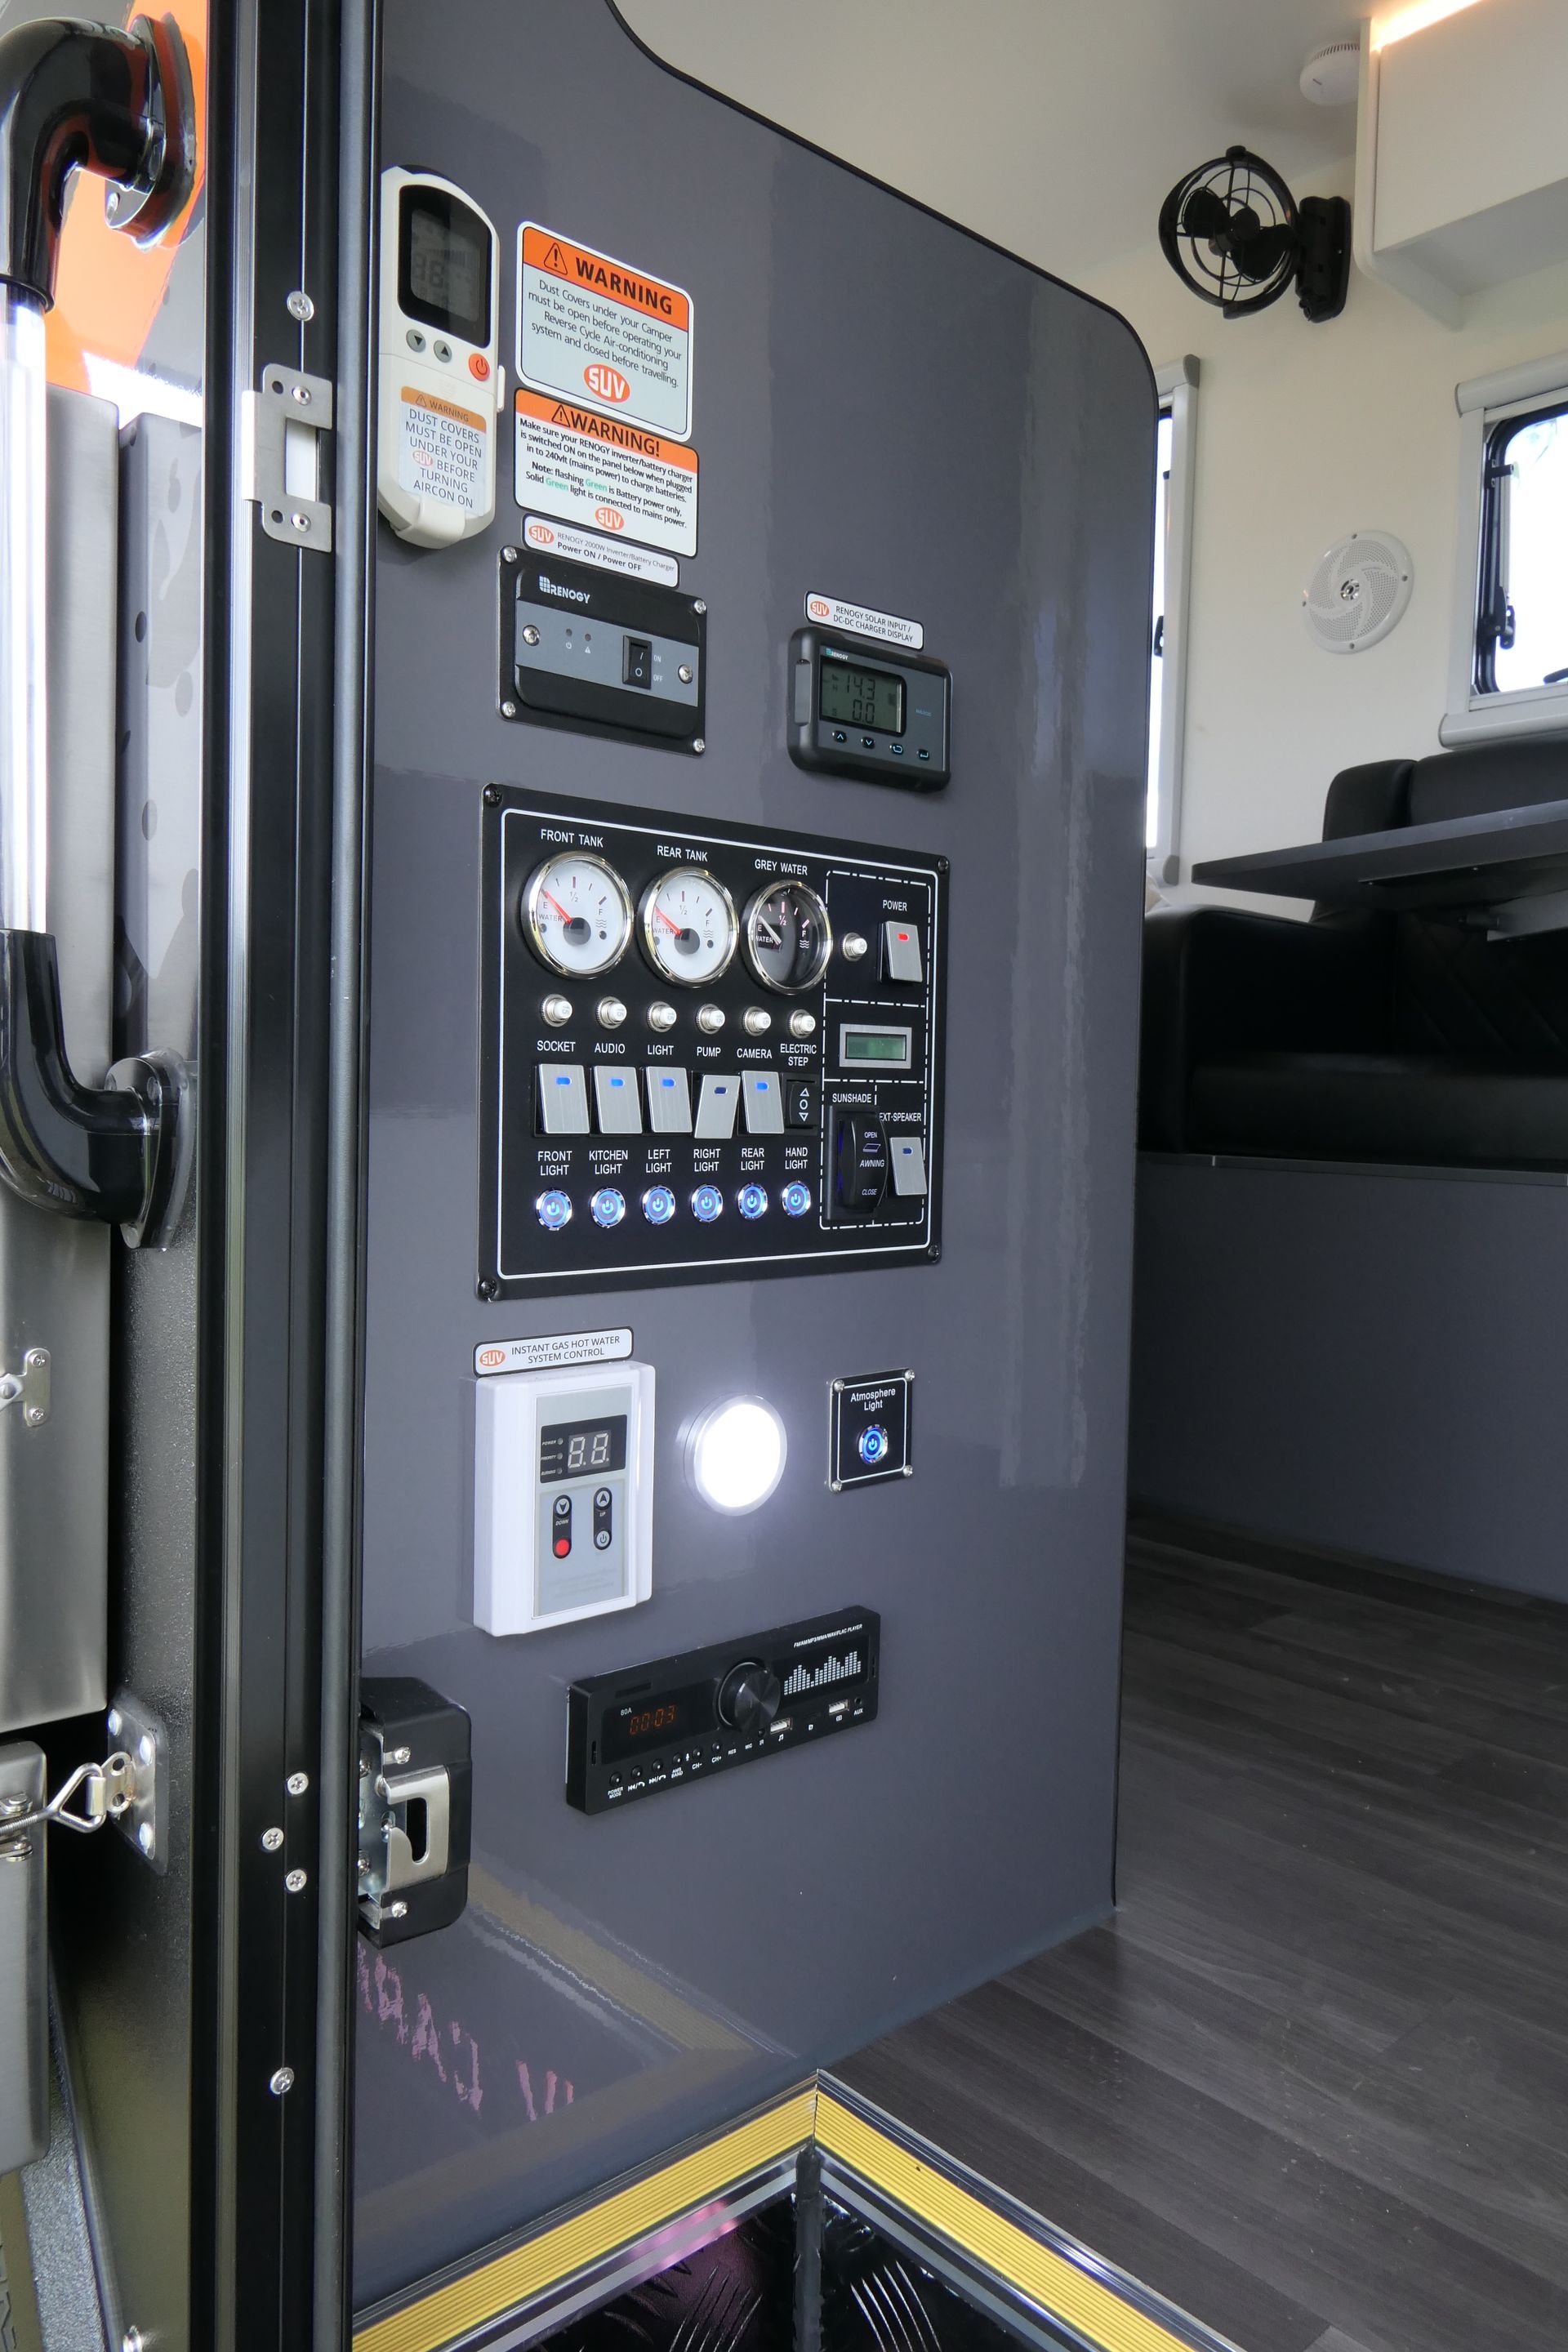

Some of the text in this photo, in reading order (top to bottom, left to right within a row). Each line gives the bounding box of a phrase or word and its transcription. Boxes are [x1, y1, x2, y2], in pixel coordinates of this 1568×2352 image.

[576, 257, 672, 314] WARNING
[539, 279, 673, 343] Dust Covers under your Camper
[528, 292, 681, 360] must be open before operating your
[544, 311, 668, 371] Reverse Cycle Air-conditioning
[532, 323, 679, 388] system and closed before travelling.
[589, 368, 626, 399] SUV
[430, 400, 469, 422] WARNING
[410, 409, 479, 443] DUST COVERS
[571, 411, 660, 457] WARNING!
[406, 421, 482, 458] MUST BE OPEN
[410, 437, 478, 470] UNDER YOUR
[520, 418, 693, 483] Make sure your RENOGY inverter/battery charger
[414, 452, 474, 482] SUV BEFORE
[520, 430, 527, 439] is
[528, 434, 562, 450] switched
[564, 444, 575, 455] ON
[588, 453, 600, 463] the
[603, 458, 621, 470] panel
[624, 465, 644, 477] below
[646, 473, 665, 483] when
[666, 479, 692, 493] plugged
[421, 468, 467, 492] TURNING
[527, 443, 533, 452] in
[536, 448, 543, 456] to
[546, 450, 568, 464] 240vlt
[569, 458, 594, 473] (mains
[595, 468, 621, 483] power)
[630, 478, 653, 492] charge
[655, 485, 687, 503] batteries.
[414, 480, 473, 508] AIRCON ON
[532, 461, 682, 516] Note: flashing Green is Battery power only,
[526, 471, 544, 483] Solid
[546, 478, 568, 491] Green
[570, 485, 586, 497] light
[588, 491, 594, 499] is
[595, 494, 632, 511] connected
[642, 509, 662, 521] mains
[665, 515, 687, 528] power.
[599, 510, 621, 528] SUV
[532, 527, 674, 571] SUV RENOGY 2000W Inverter/Battery Charger
[558, 542, 581, 554] Power
[584, 550, 595, 559] ON
[603, 555, 626, 567] Power
[628, 562, 642, 571] OFF
[550, 584, 590, 604] RENOGY
[812, 603, 827, 615] SUV
[836, 605, 863, 619] RENOGY
[865, 614, 885, 626] SOLAR
[888, 621, 906, 631] INPUT
[834, 615, 912, 642] DC-DC CHARGER DISPLAY
[541, 829, 604, 848] FRONT TANK
[657, 845, 707, 862] REAR TANK
[755, 859, 808, 875] GREY WATER
[883, 900, 907, 911] POWER
[539, 914, 563, 922] WATER
[537, 1040, 576, 1052] SOCKET
[595, 1043, 626, 1054] AUDIO
[648, 1045, 674, 1055] LIGHT
[697, 1047, 721, 1057] PUMP
[737, 1049, 772, 1058] CAMERA
[780, 1044, 817, 1054] ELECTRIC
[788, 1057, 808, 1067] STEP
[832, 1093, 871, 1103] SUNSHADE
[880, 1113, 921, 1121] EXT-SPEAKER
[537, 1151, 572, 1161] FRONT
[589, 1150, 628, 1160] KITCHEN
[648, 1149, 670, 1160] LEFT
[693, 1148, 721, 1159] RIGHT
[742, 1147, 764, 1158] REAR
[786, 1147, 808, 1157] HAND
[540, 1165, 569, 1176] LIGHT
[595, 1164, 622, 1174] LIGHT
[646, 1162, 672, 1173] LIGHT
[694, 1161, 719, 1172] LIGHT
[741, 1160, 764, 1170] LIGHT
[785, 1160, 808, 1169] LIGHT
[860, 1160, 884, 1168] AWNING
[482, 1336, 620, 1365] SUV INSTANT GAS HOT WATER
[528, 1348, 604, 1364] SYSTEM CONTROL
[850, 1388, 896, 1402] Atmosphere
[864, 1400, 883, 1411] Light
[848, 1624, 862, 1633] PLAYER
